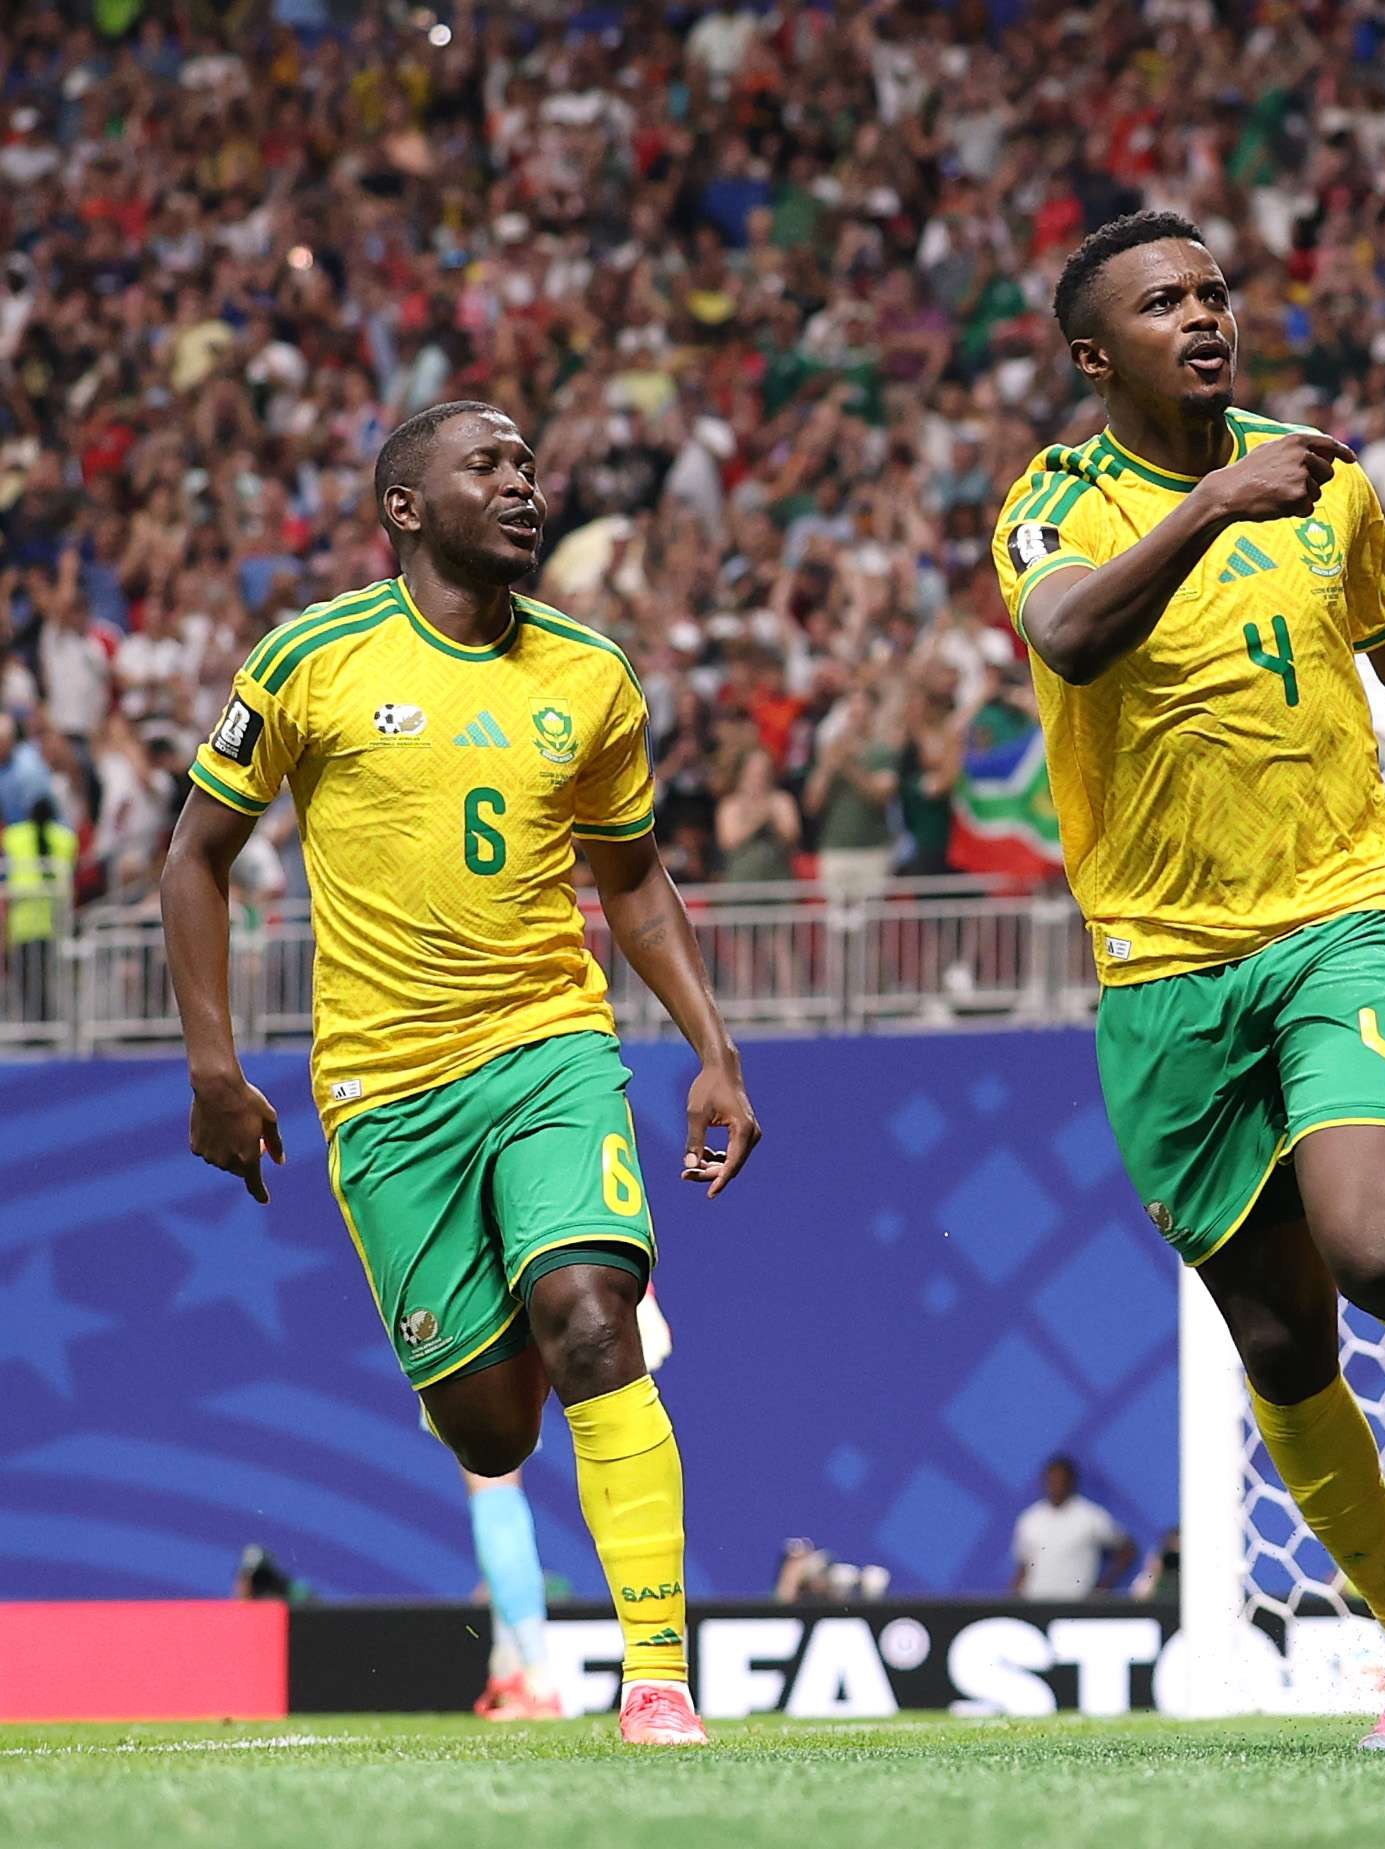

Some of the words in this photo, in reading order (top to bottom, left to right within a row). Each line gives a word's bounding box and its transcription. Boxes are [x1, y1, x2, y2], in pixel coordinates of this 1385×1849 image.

[1244, 614, 1299, 707] 4
[464, 787, 507, 876] 6
[602, 1133, 643, 1217] 6
[621, 1580, 683, 1603] SAFA
[544, 1617, 899, 1719] FFA
